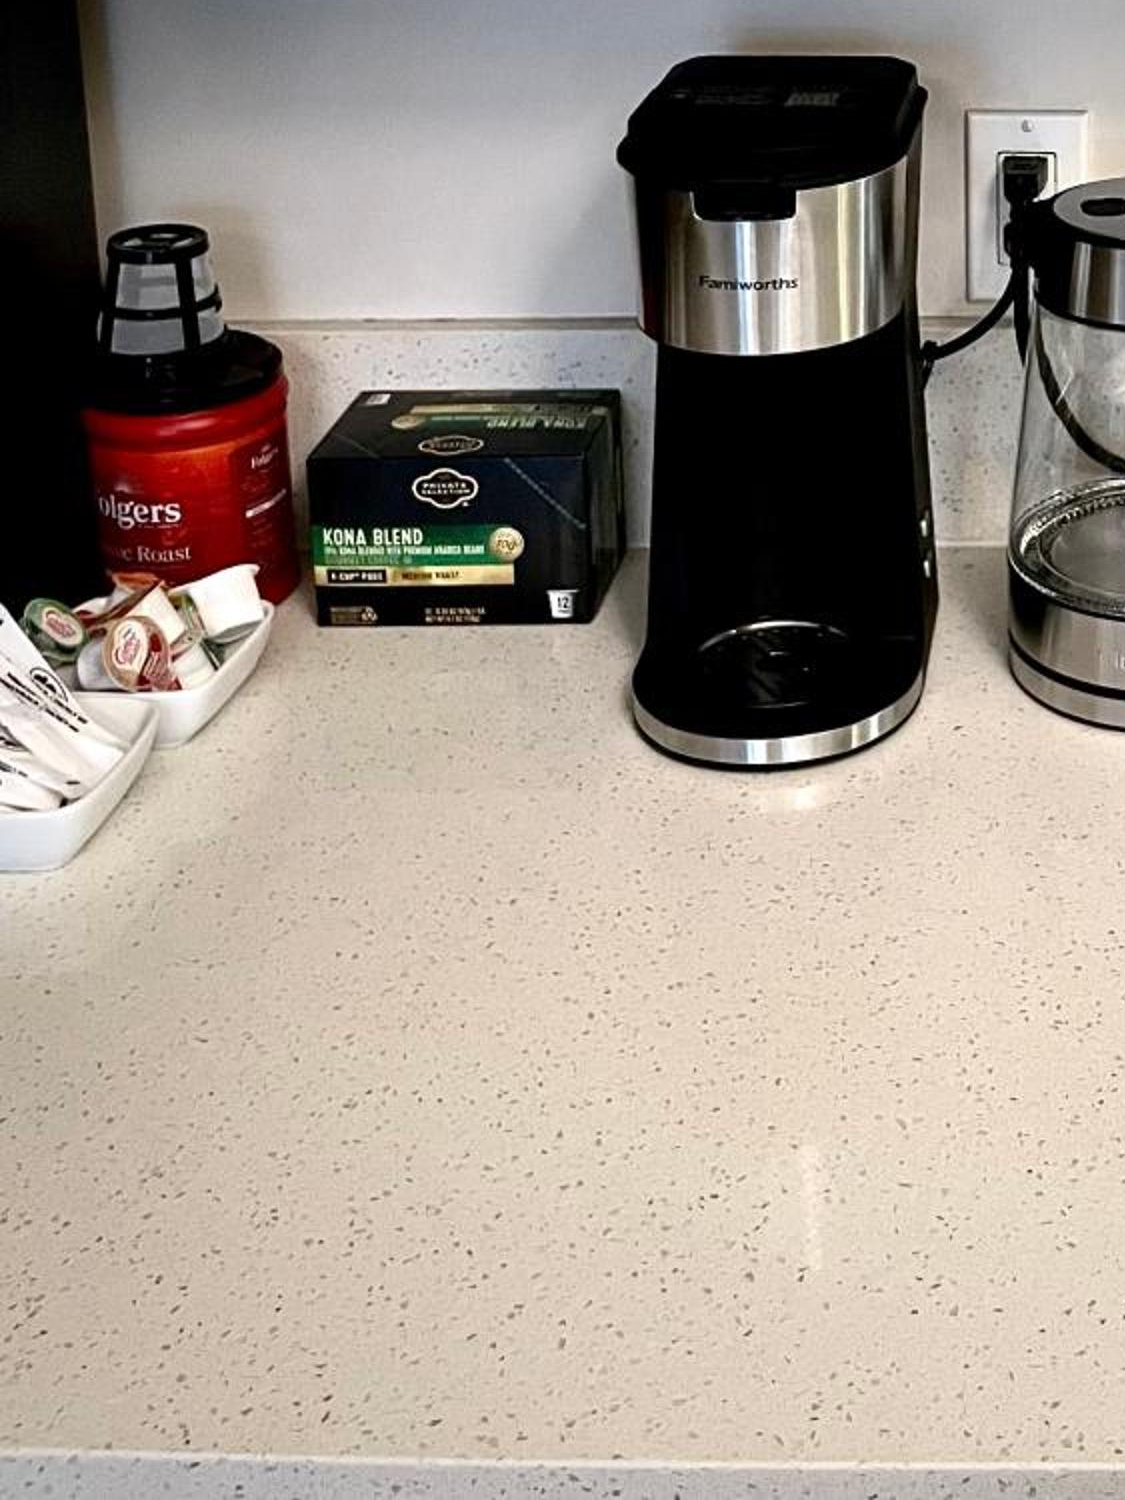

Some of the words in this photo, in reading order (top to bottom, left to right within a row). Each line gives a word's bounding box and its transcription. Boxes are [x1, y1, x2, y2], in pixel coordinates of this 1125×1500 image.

[97, 493, 182, 531] olgers
[322, 527, 367, 546] KONA
[372, 527, 424, 546] BLEND
[136, 545, 192, 564] Roast
[557, 596, 570, 609] 12
